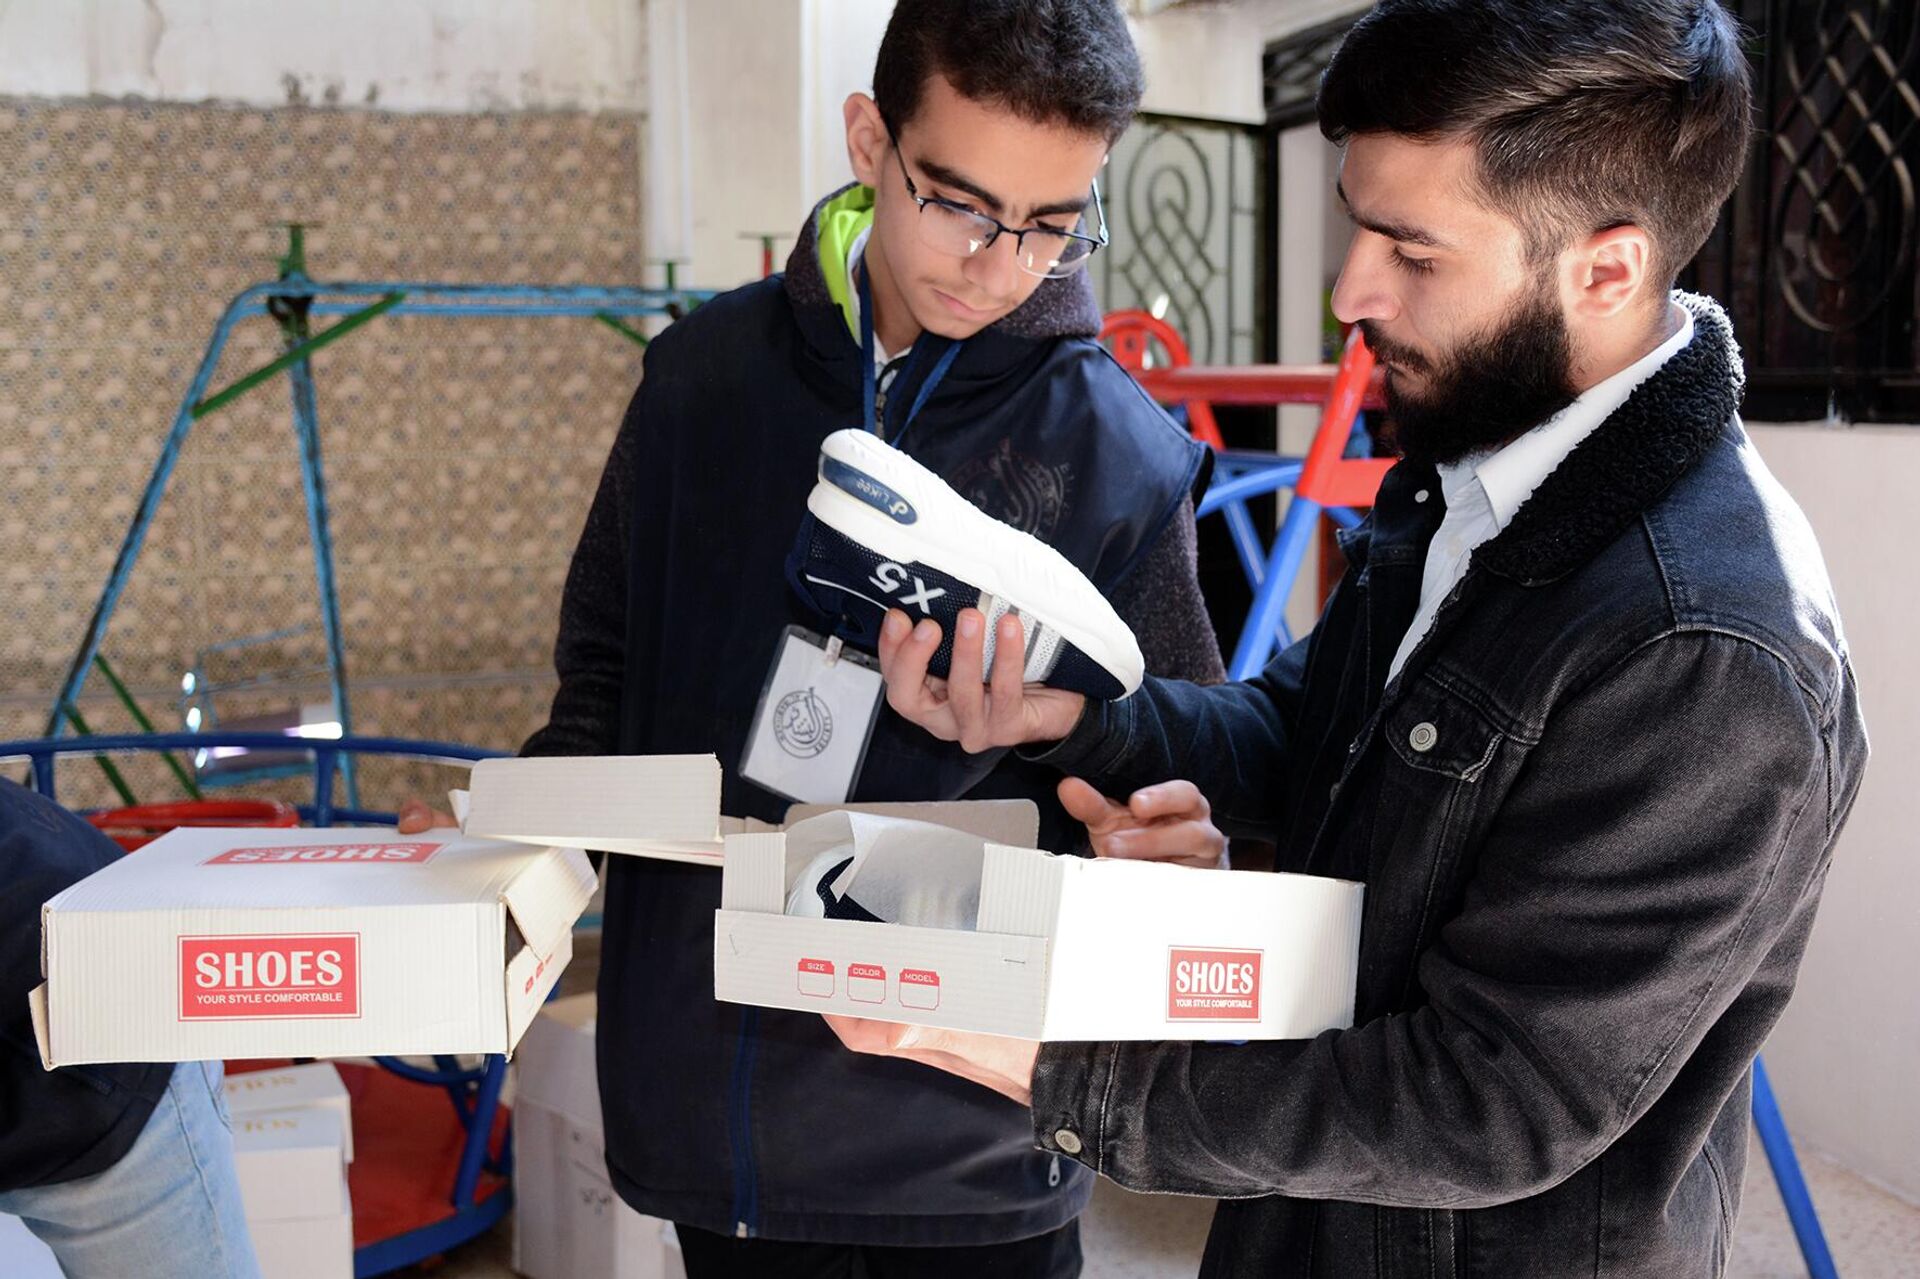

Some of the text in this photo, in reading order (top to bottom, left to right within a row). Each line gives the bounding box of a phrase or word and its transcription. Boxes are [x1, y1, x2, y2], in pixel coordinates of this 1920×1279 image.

[868, 562, 947, 615] X5
[229, 847, 416, 861] SHOES
[195, 950, 343, 988] SHOES
[807, 962, 825, 971] SIZE
[852, 967, 881, 977] COLOR
[904, 972, 934, 983] MODEL
[1175, 960, 1254, 995] SHOES
[196, 991, 343, 1005] YOUR STYLE COMFORTABLE
[1176, 998, 1252, 1008] YOUR STYLE COMFORTABLE
